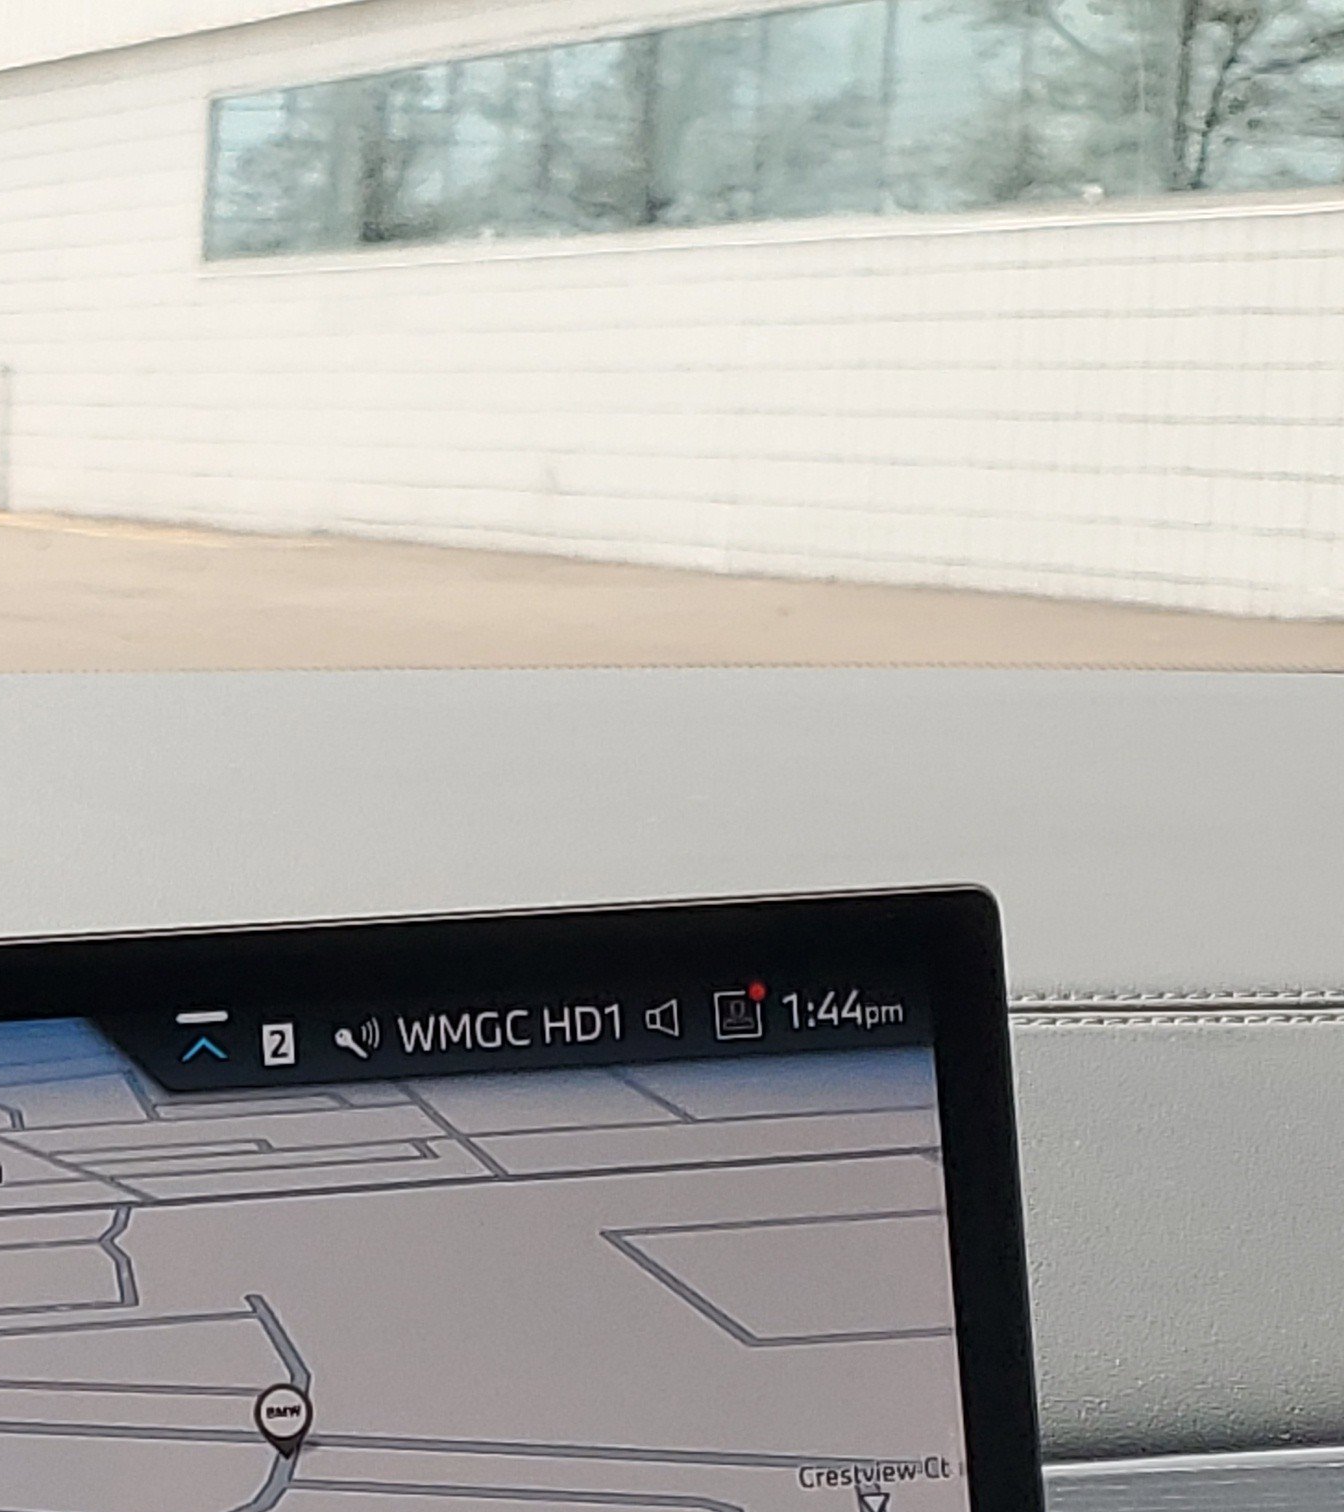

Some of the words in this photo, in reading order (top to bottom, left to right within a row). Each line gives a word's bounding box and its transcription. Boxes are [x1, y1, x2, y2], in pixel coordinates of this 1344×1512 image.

[397, 1009, 532, 1054] WMGC
[542, 1003, 621, 1045] HD1
[798, 1461, 918, 1488] Crestview
[924, 1456, 950, 1479] Ct
